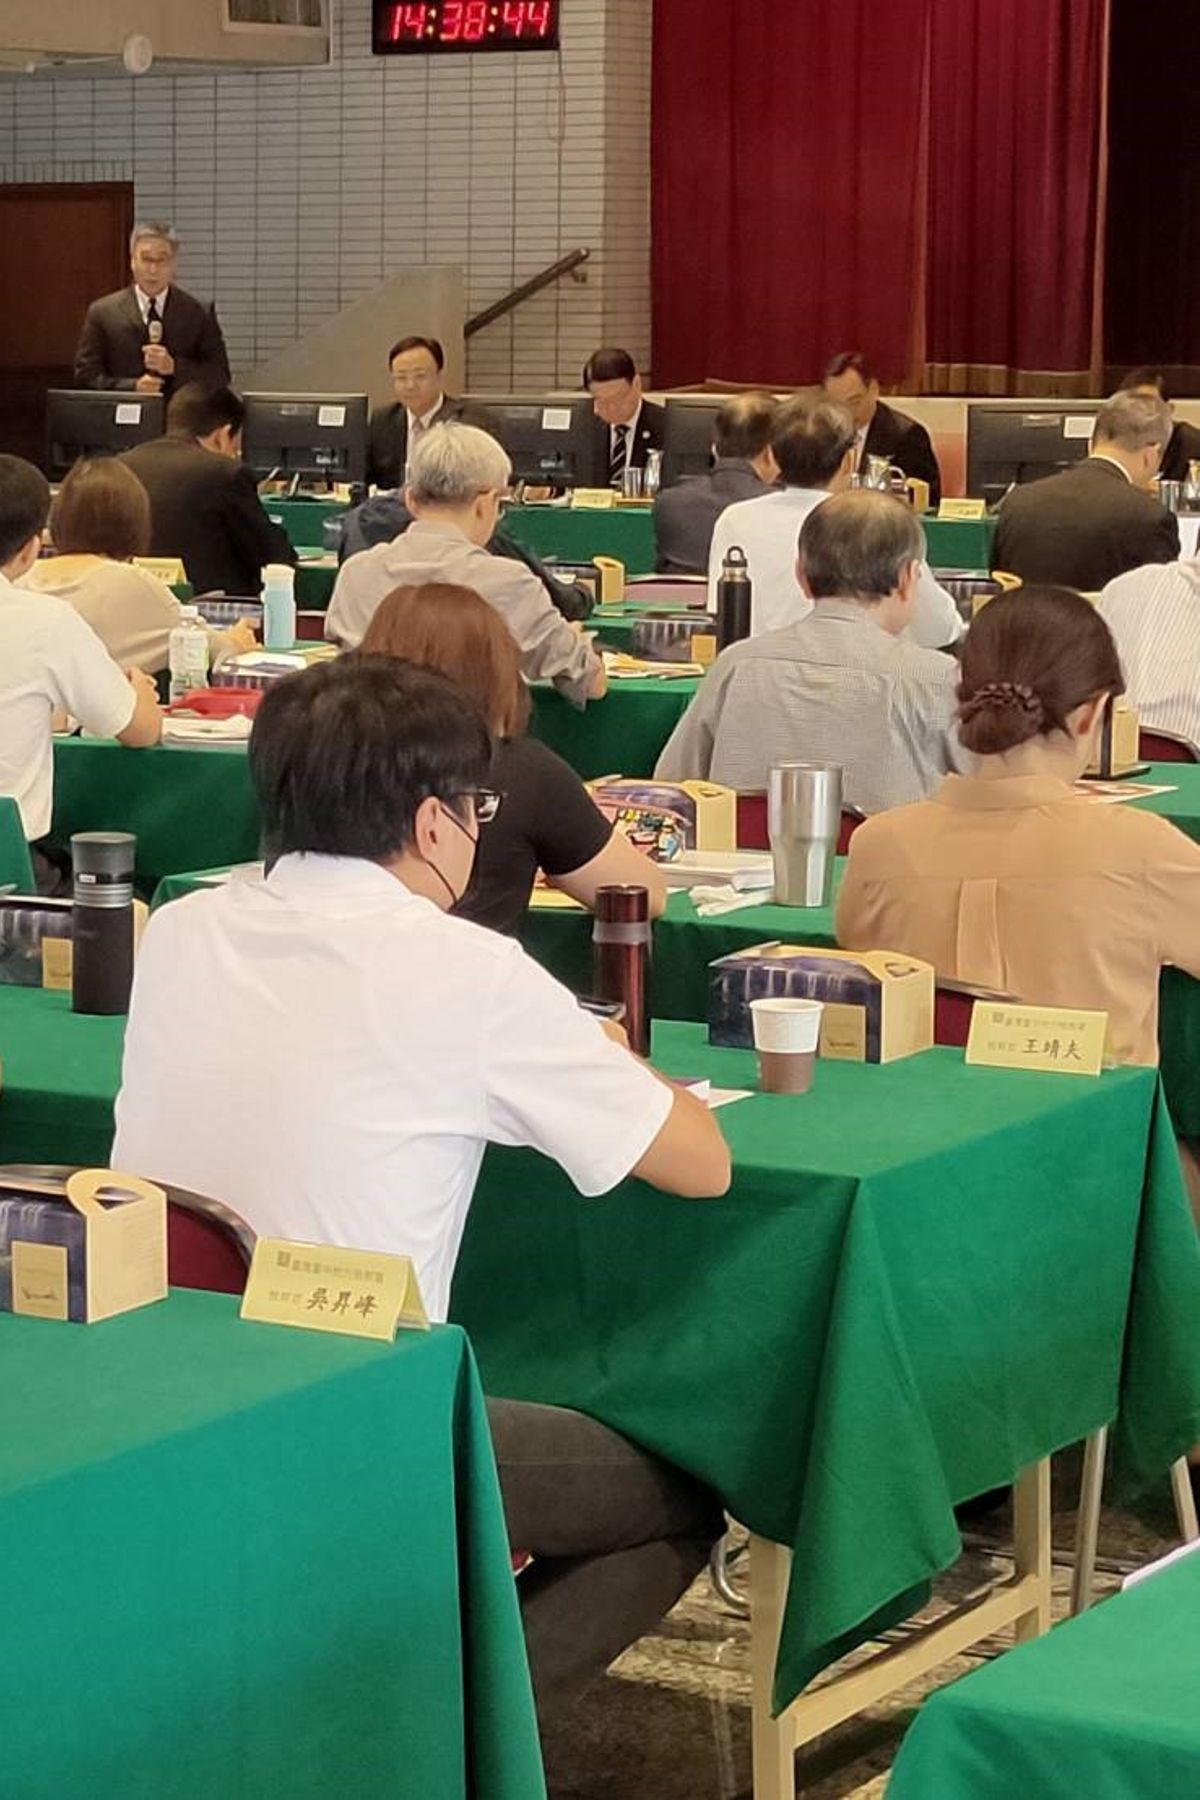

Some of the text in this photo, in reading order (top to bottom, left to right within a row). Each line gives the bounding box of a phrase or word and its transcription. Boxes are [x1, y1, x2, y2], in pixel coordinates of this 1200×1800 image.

[391, 1, 550, 40] 14:38:44
[1022, 1039, 1081, 1060] 王靖夫
[306, 1287, 380, 1318] 吳昇峰
